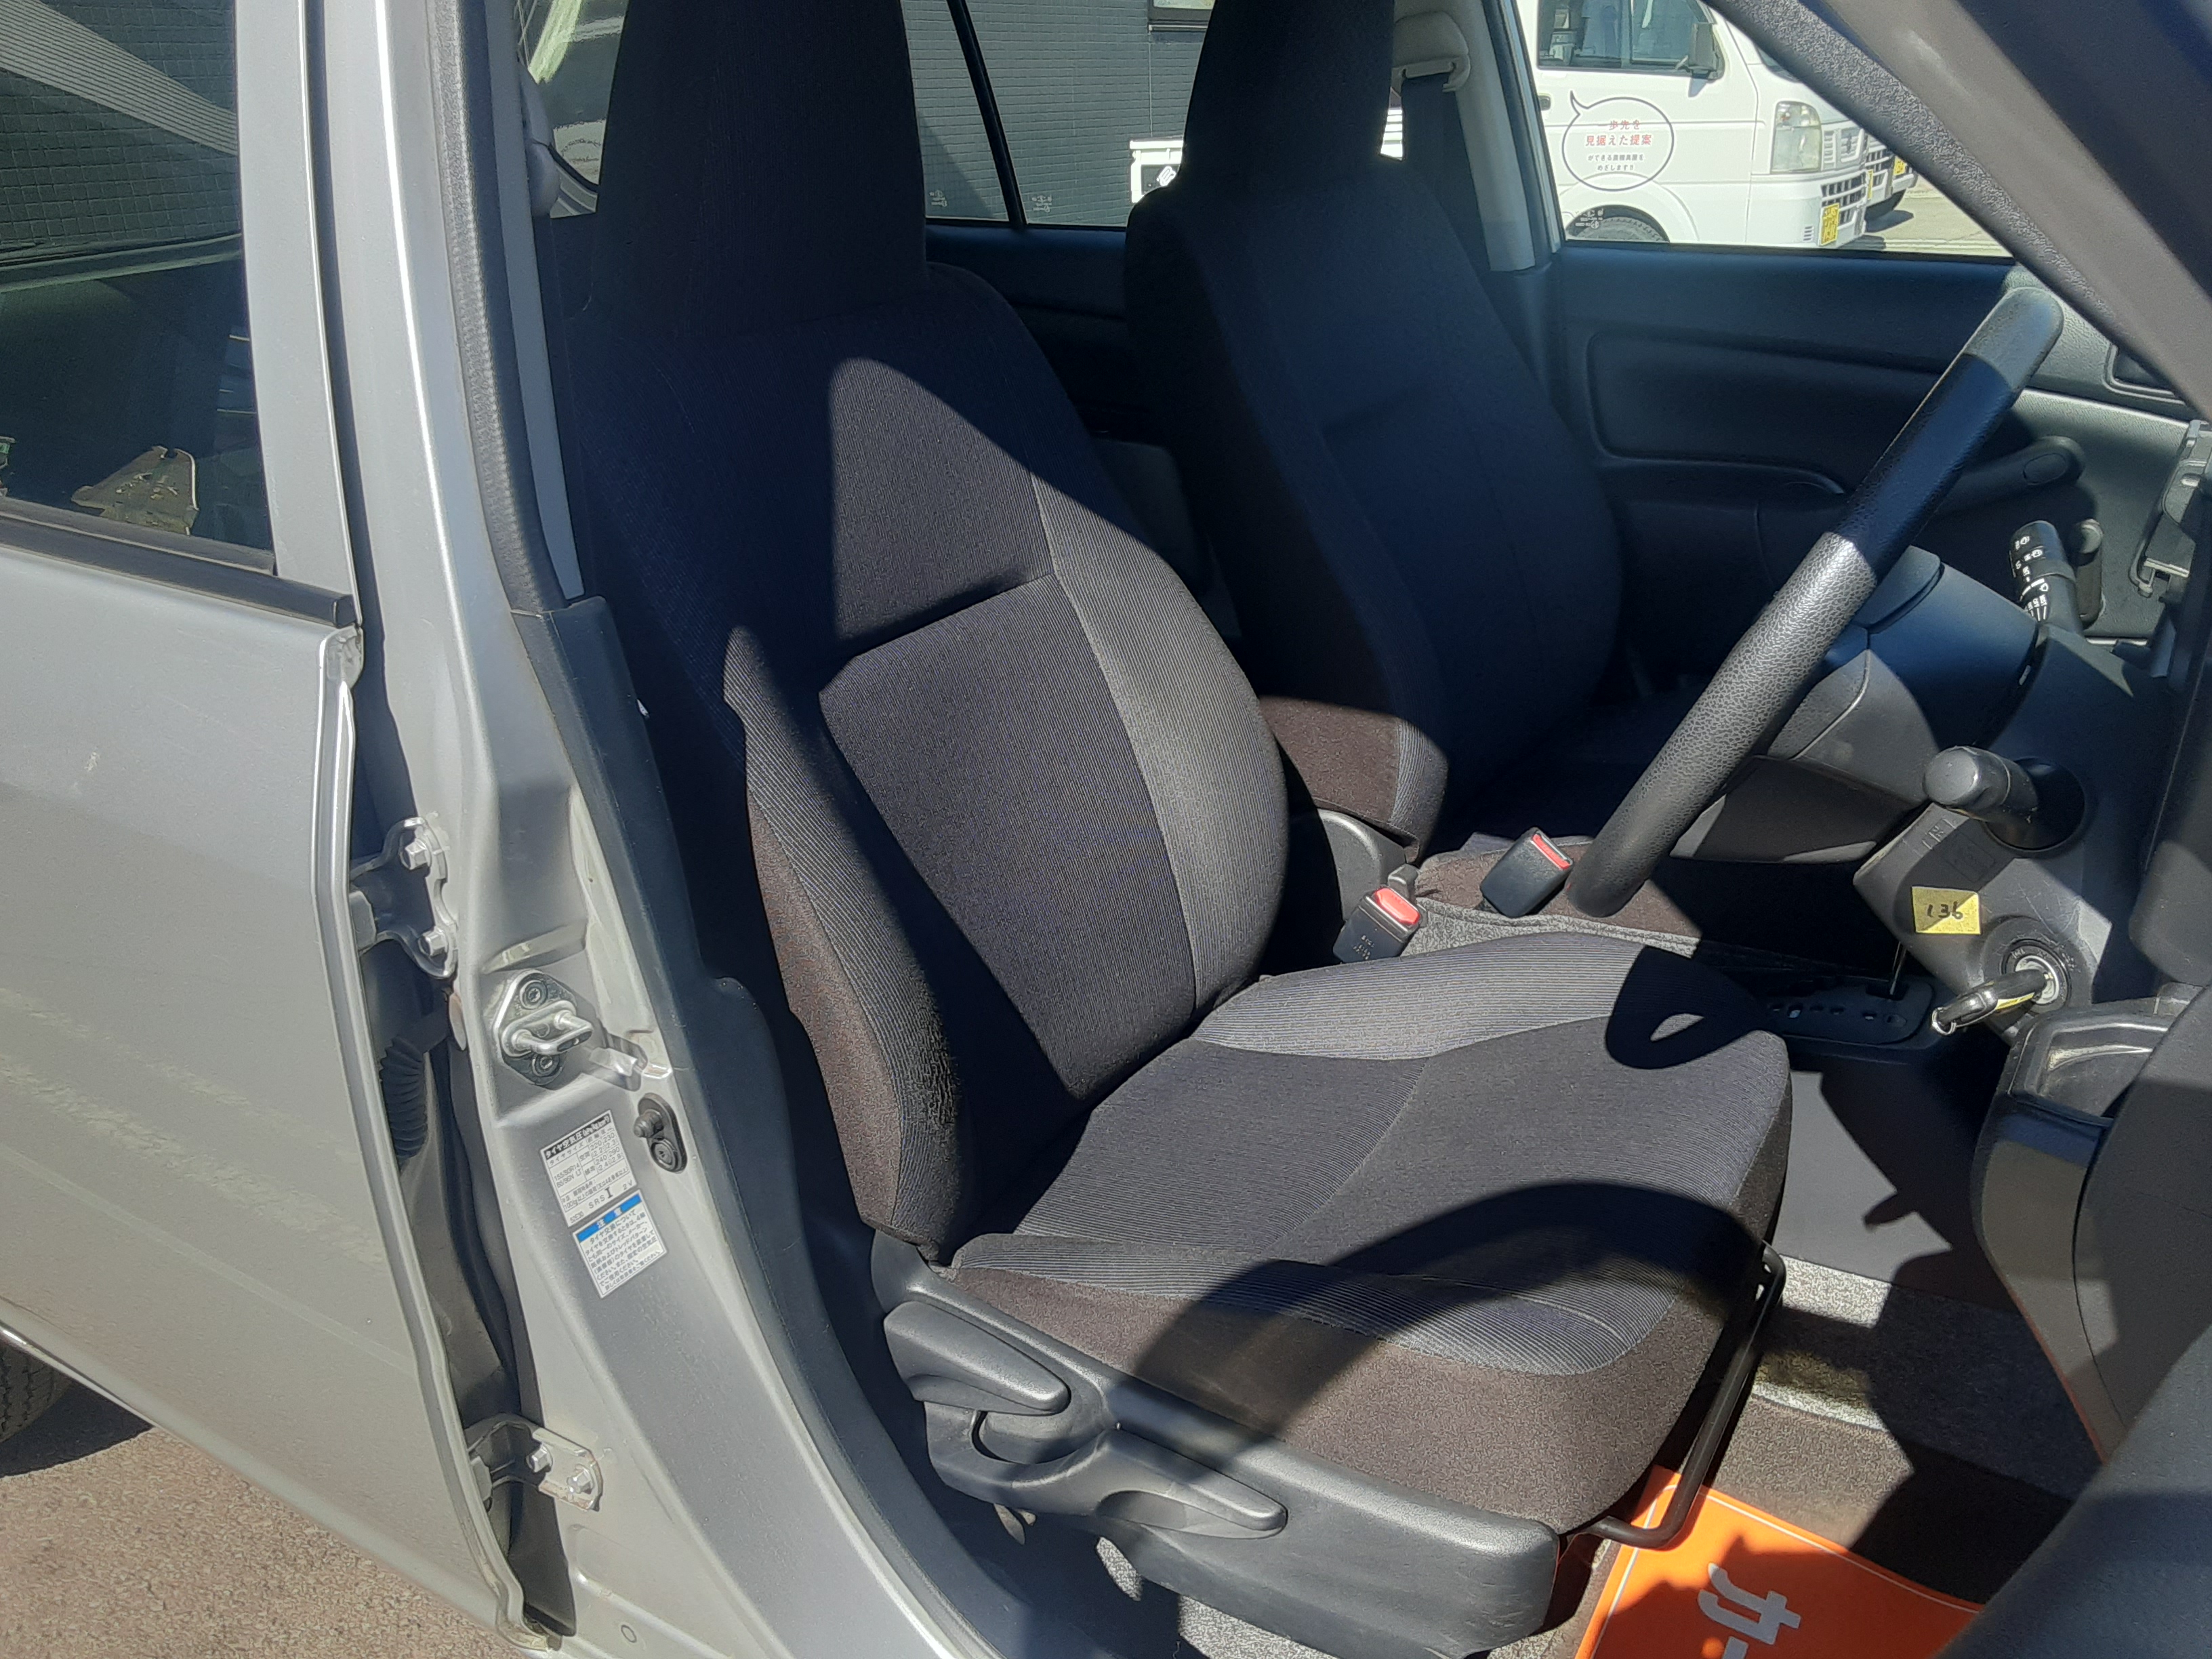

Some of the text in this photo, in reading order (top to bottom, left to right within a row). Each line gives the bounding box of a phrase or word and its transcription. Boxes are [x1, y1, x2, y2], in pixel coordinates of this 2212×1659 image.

[1598, 119, 1641, 130] 一歩先を
[1585, 134, 1652, 146] 見据えた提案
[603, 1132, 614, 1142] 230
[590, 1209, 636, 1244] タイヤ交換について
